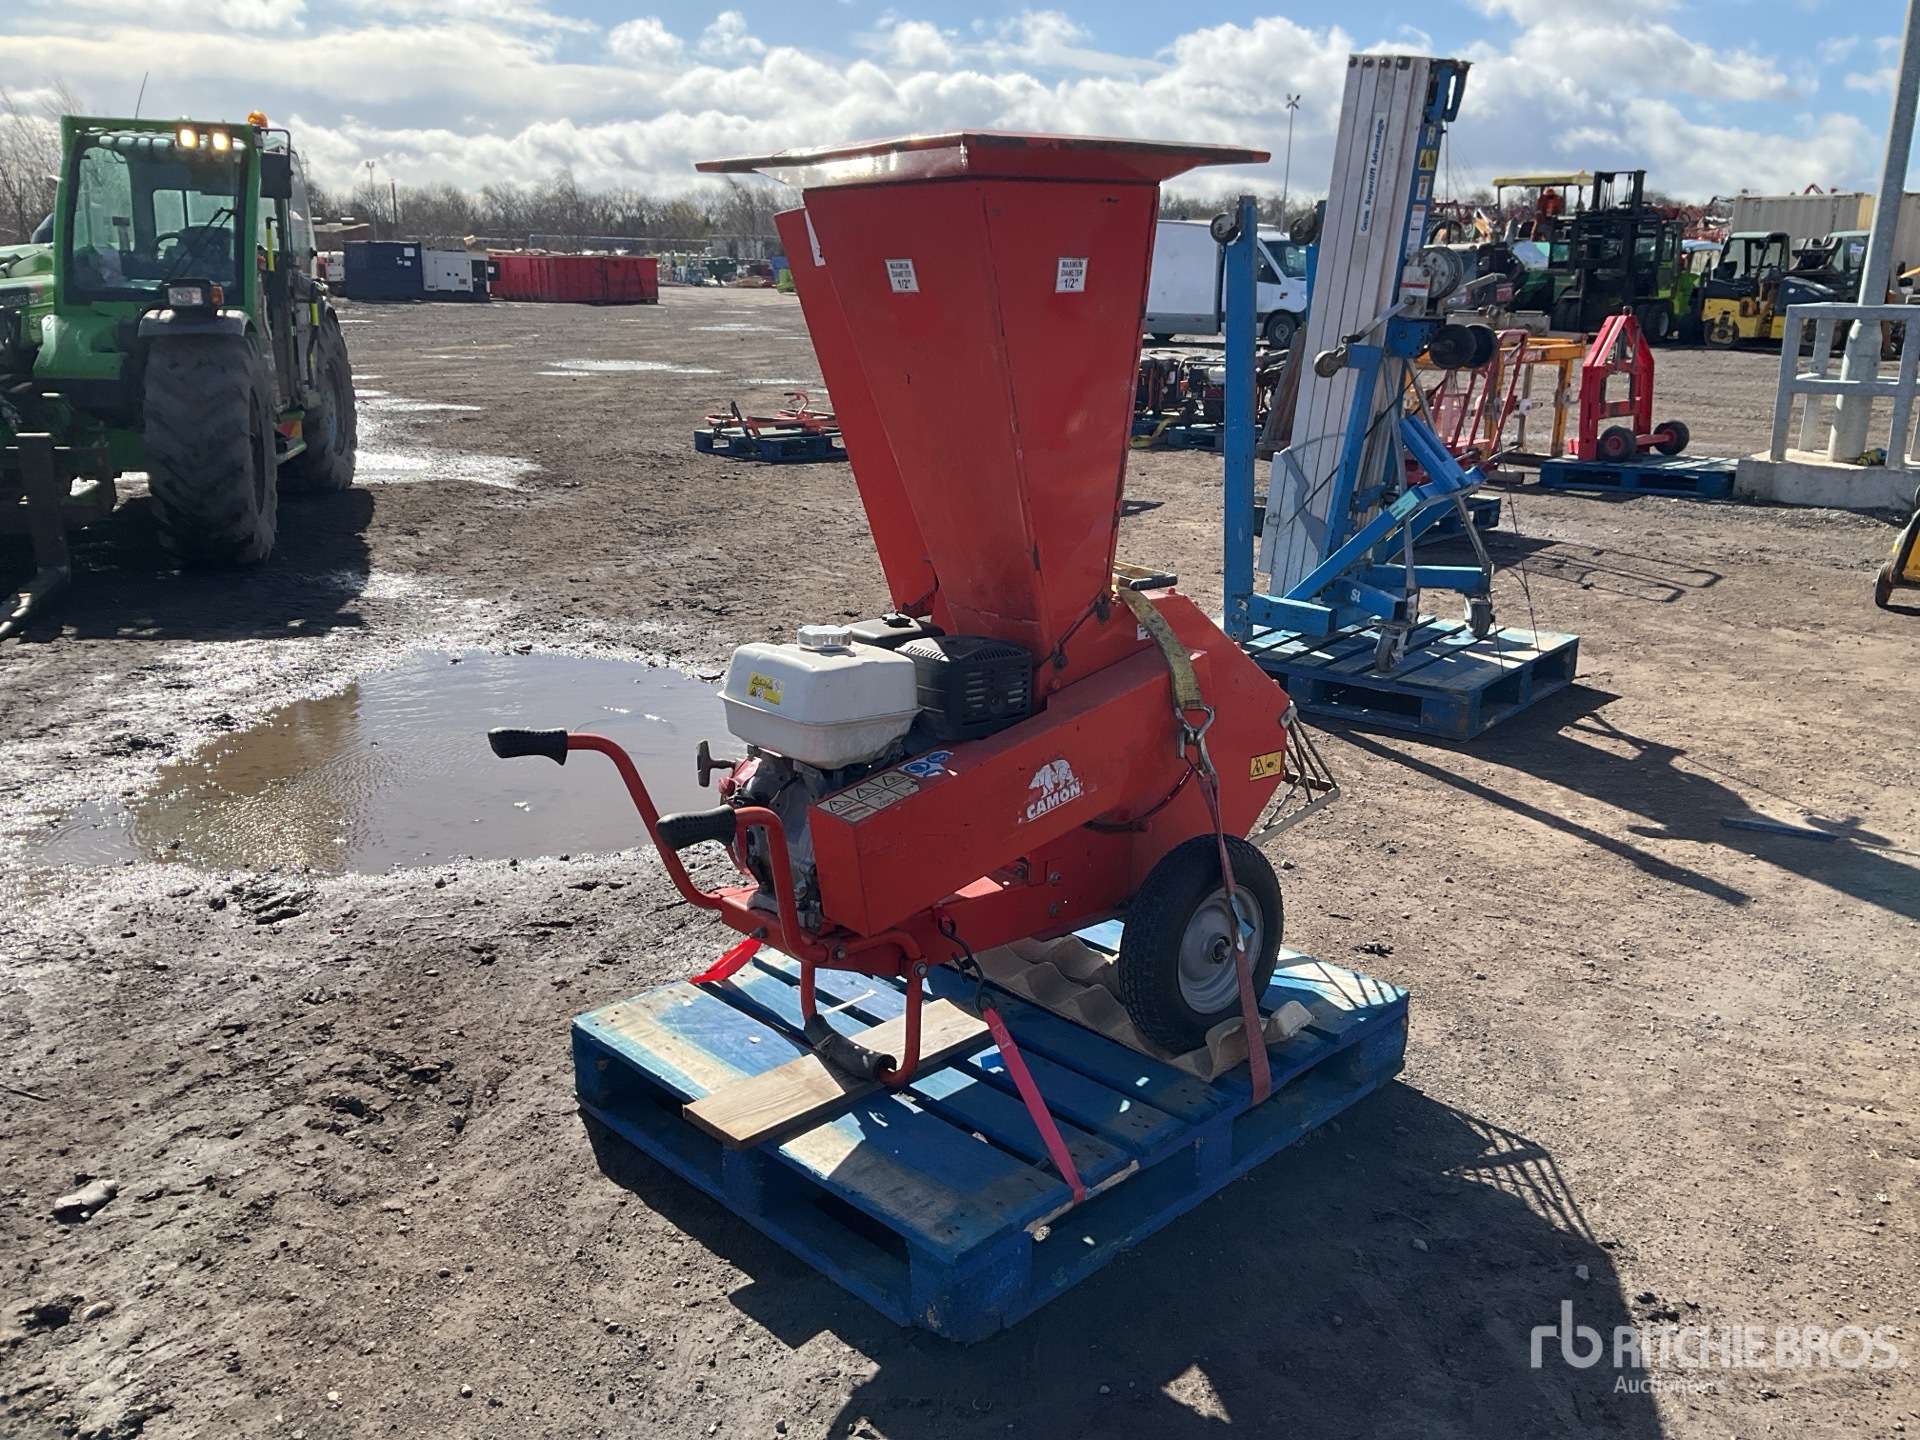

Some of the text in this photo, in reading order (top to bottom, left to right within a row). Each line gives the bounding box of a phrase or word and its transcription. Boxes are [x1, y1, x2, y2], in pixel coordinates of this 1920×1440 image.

[1365, 167, 1376, 206] Superlift
[1371, 118, 1385, 165] Advantage
[1026, 781, 1081, 819] CAMON
